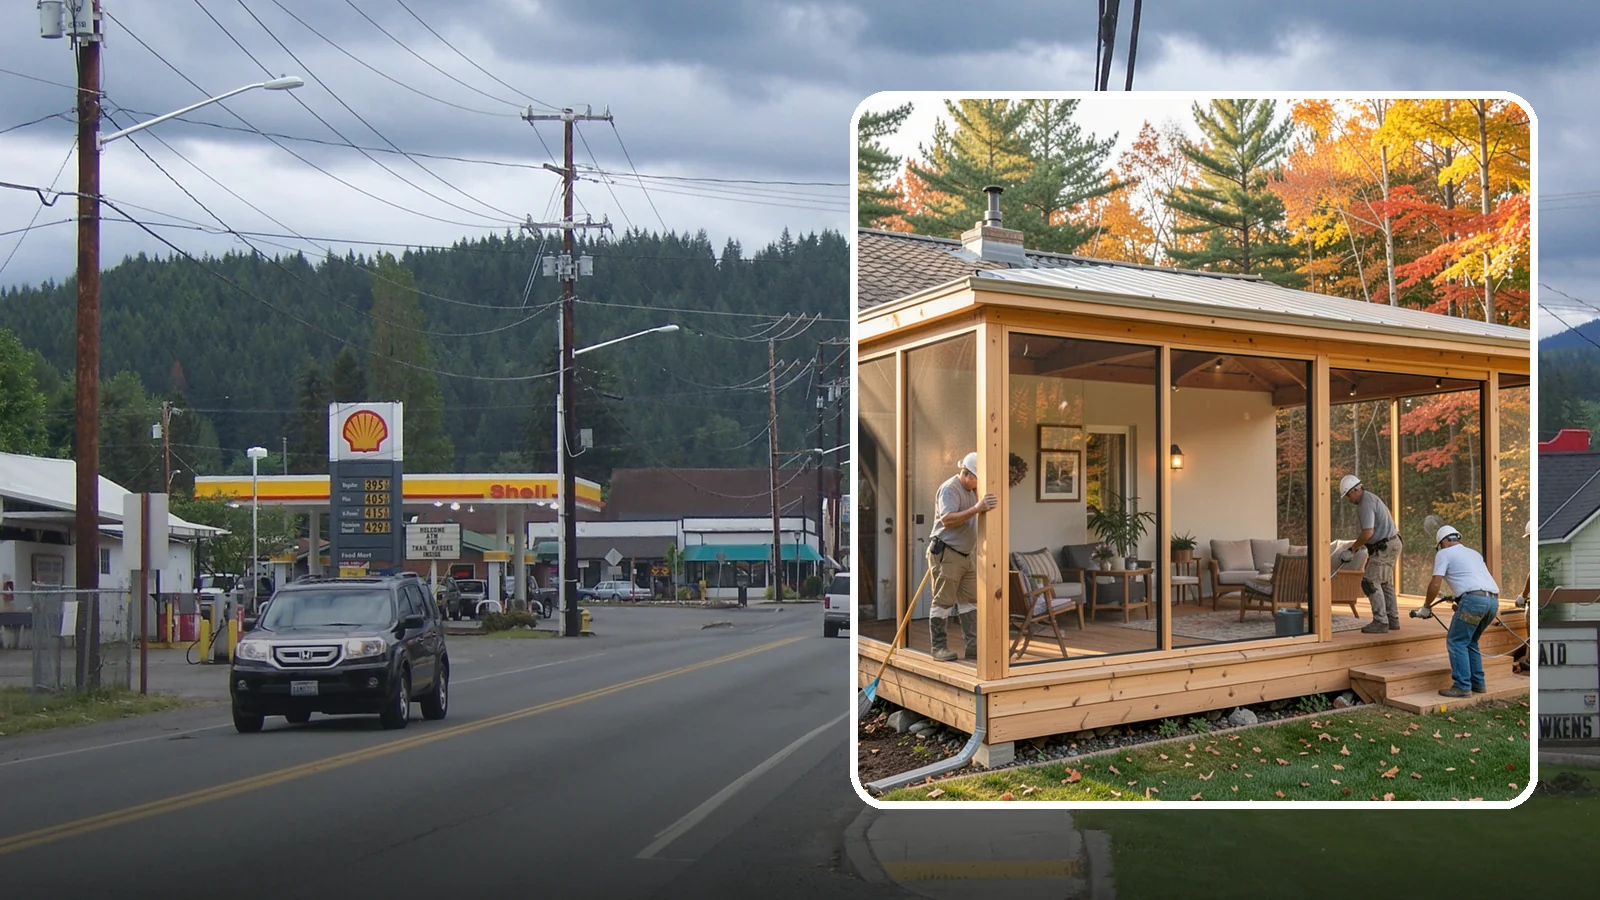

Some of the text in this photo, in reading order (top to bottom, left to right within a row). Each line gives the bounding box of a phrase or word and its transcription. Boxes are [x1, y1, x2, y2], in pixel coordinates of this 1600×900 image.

[366, 480, 384, 491] 395
[490, 484, 547, 499] Shell
[366, 494, 384, 504] 405
[366, 508, 384, 517] 415
[366, 522, 384, 533] 429
